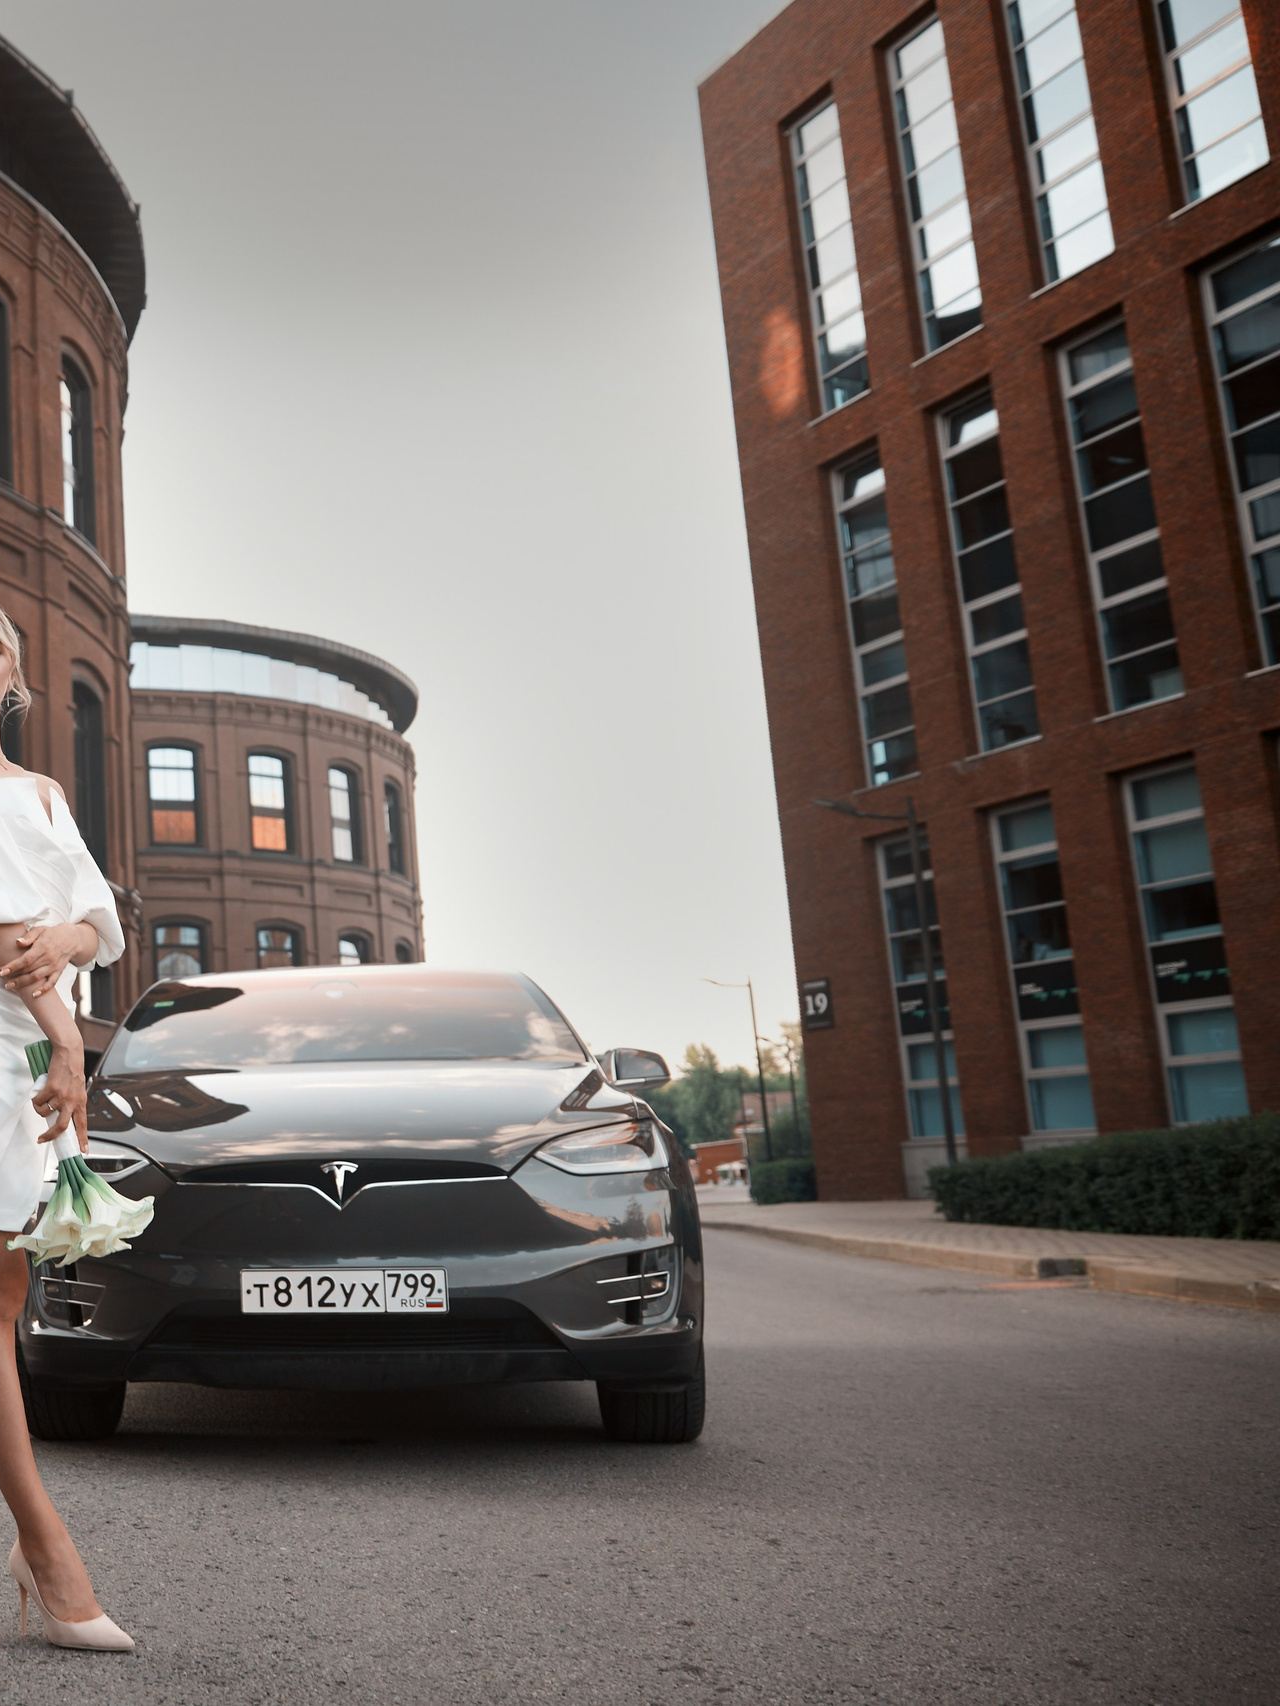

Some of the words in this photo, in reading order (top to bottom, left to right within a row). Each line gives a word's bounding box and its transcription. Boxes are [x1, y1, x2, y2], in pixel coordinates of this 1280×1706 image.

[805, 992, 829, 1016] 19
[386, 1273, 436, 1298] 799
[400, 1298, 425, 1308] RUS
